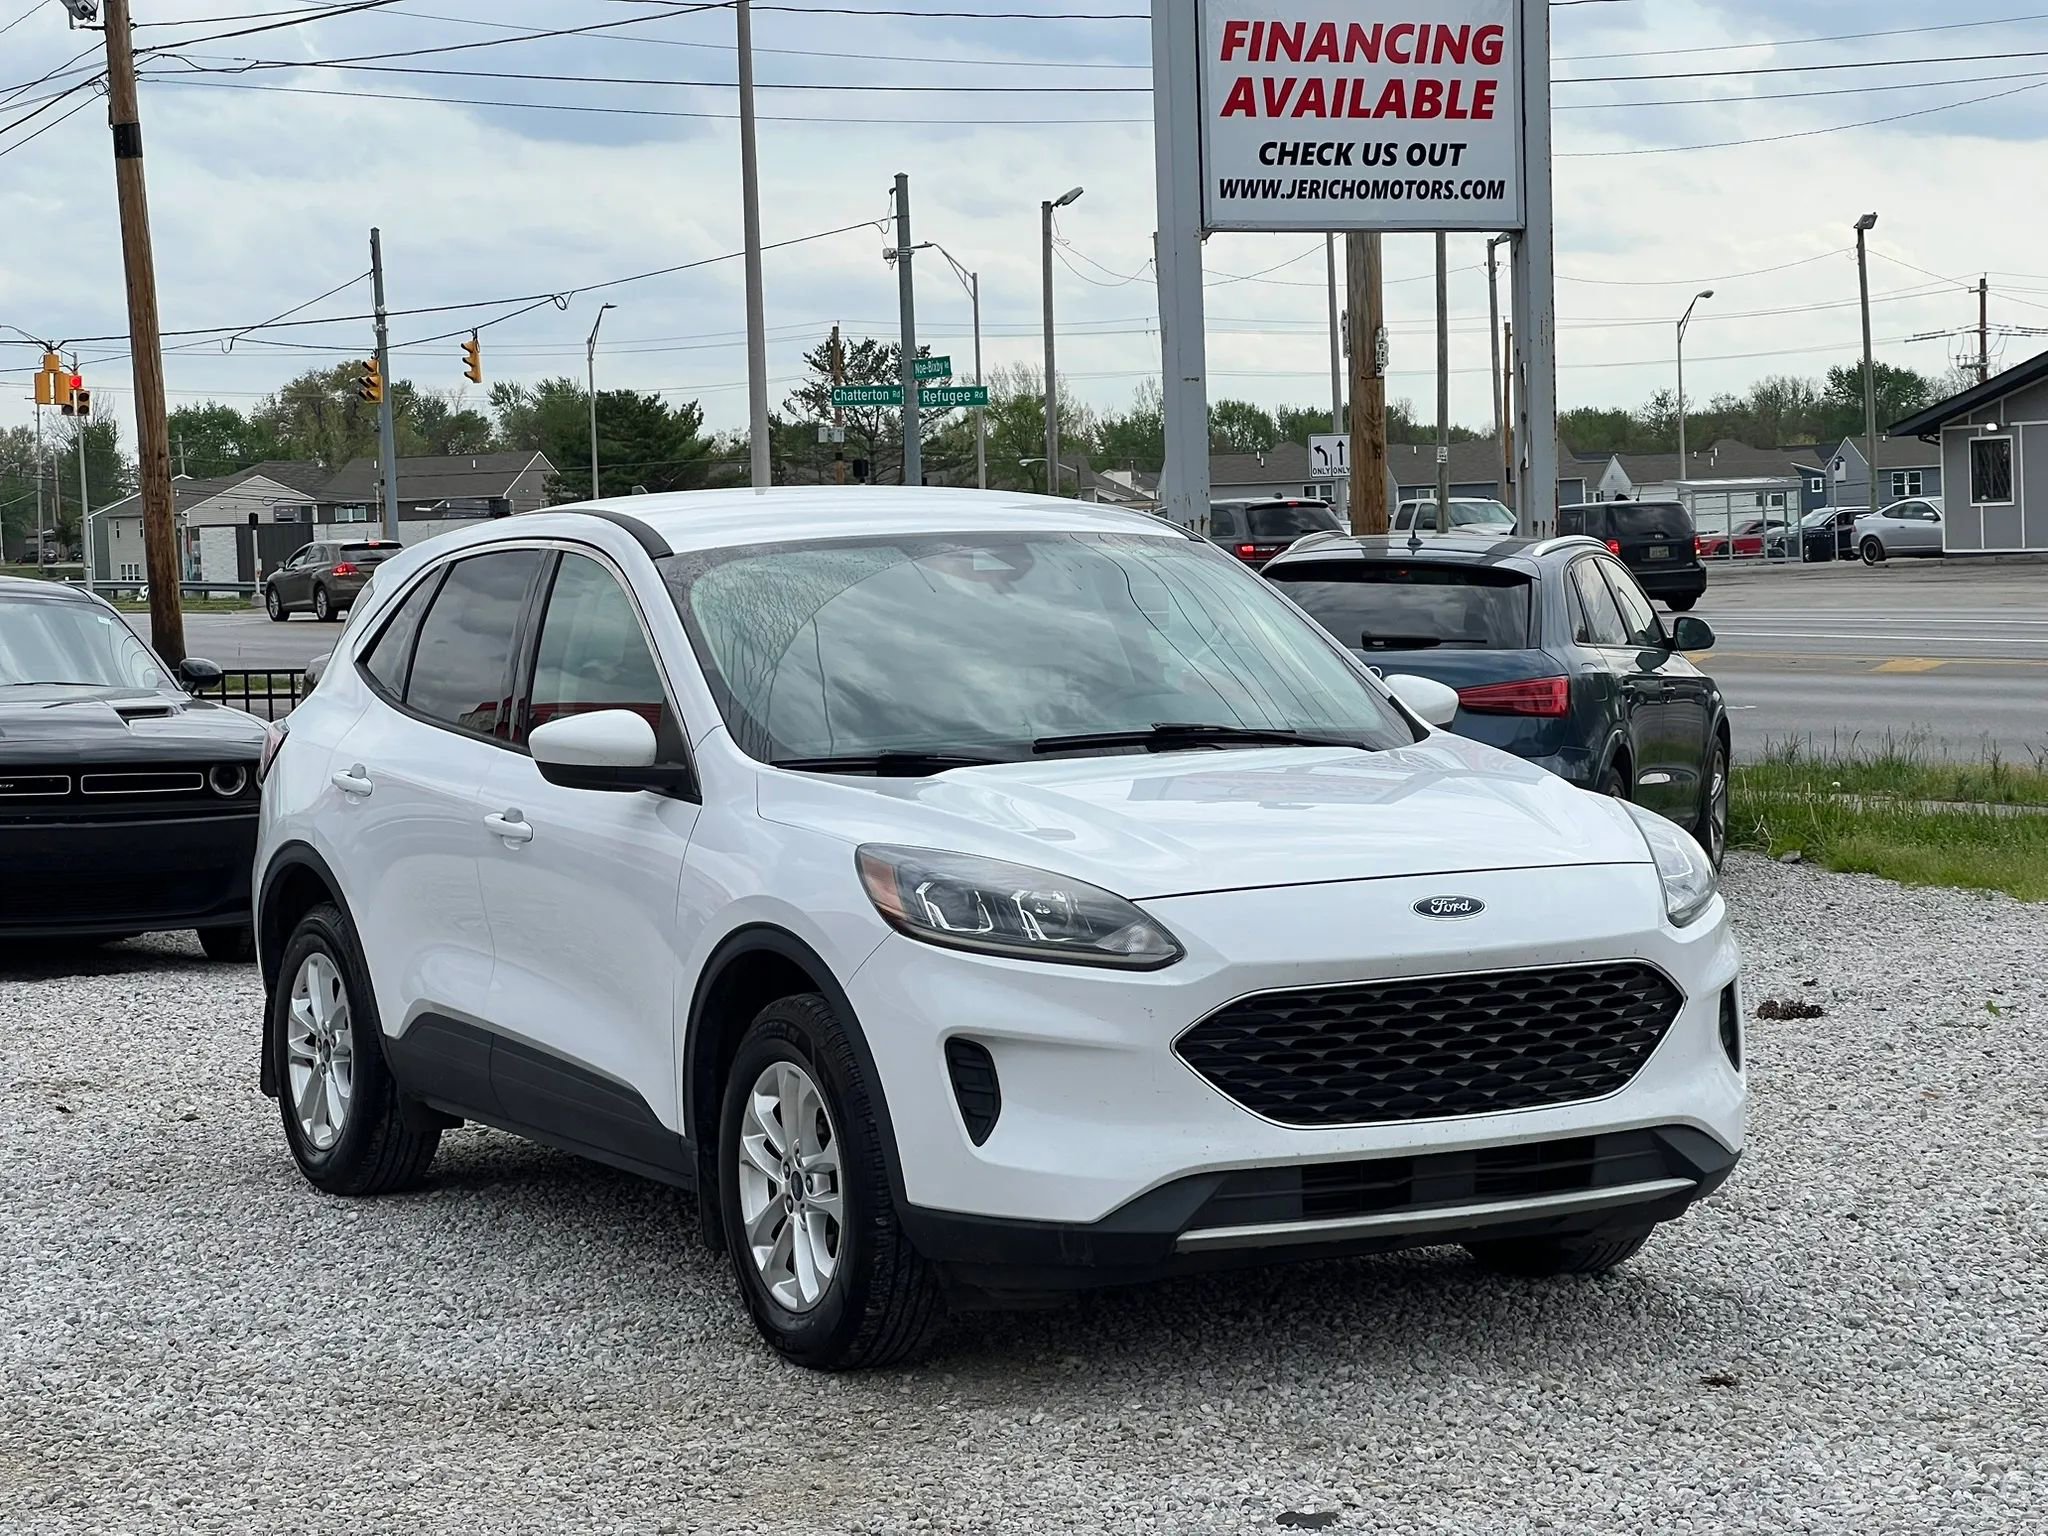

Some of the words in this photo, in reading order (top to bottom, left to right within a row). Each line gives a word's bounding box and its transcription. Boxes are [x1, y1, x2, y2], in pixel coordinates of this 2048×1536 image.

[1220, 21, 1505, 65] FINANCING
[1219, 77, 1498, 120] AVAILABLE
[1258, 141, 1353, 167] CHECK
[1361, 142, 1399, 167] US
[1406, 142, 1467, 167] OUT
[1219, 178, 1505, 200] WWW.JERICHOMOTORS.COM
[833, 389, 889, 402] Chatterton
[892, 390, 900, 398] Rd
[922, 390, 971, 406] Refugee
[974, 391, 984, 399] Rd
[1312, 467, 1330, 475] ONLY
[1333, 466, 1351, 474] ONLY
[1430, 897, 1472, 914] Ford
